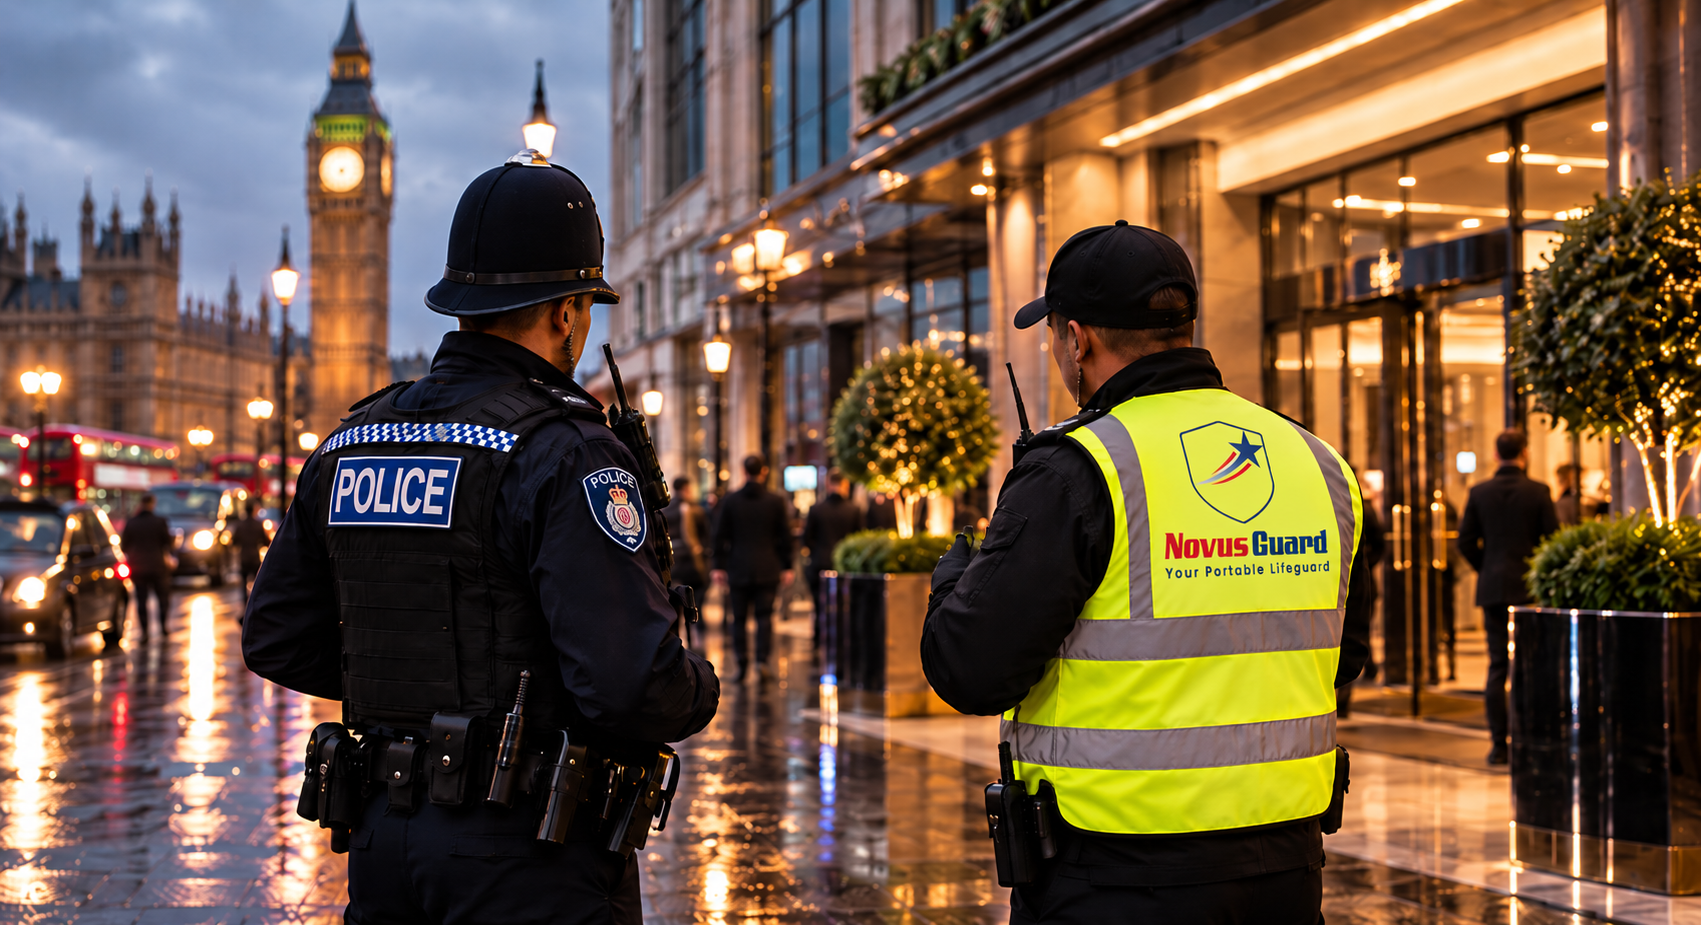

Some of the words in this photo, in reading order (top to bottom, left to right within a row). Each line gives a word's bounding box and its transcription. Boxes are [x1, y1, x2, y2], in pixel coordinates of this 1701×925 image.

[334, 466, 449, 515] POLICE
[590, 471, 635, 489] POLICE
[1165, 532, 1249, 560] Novus
[1252, 529, 1328, 556] Guard
[1165, 567, 1199, 579] Your
[1205, 563, 1264, 577] Portable
[1270, 560, 1330, 576] Lifeguard
